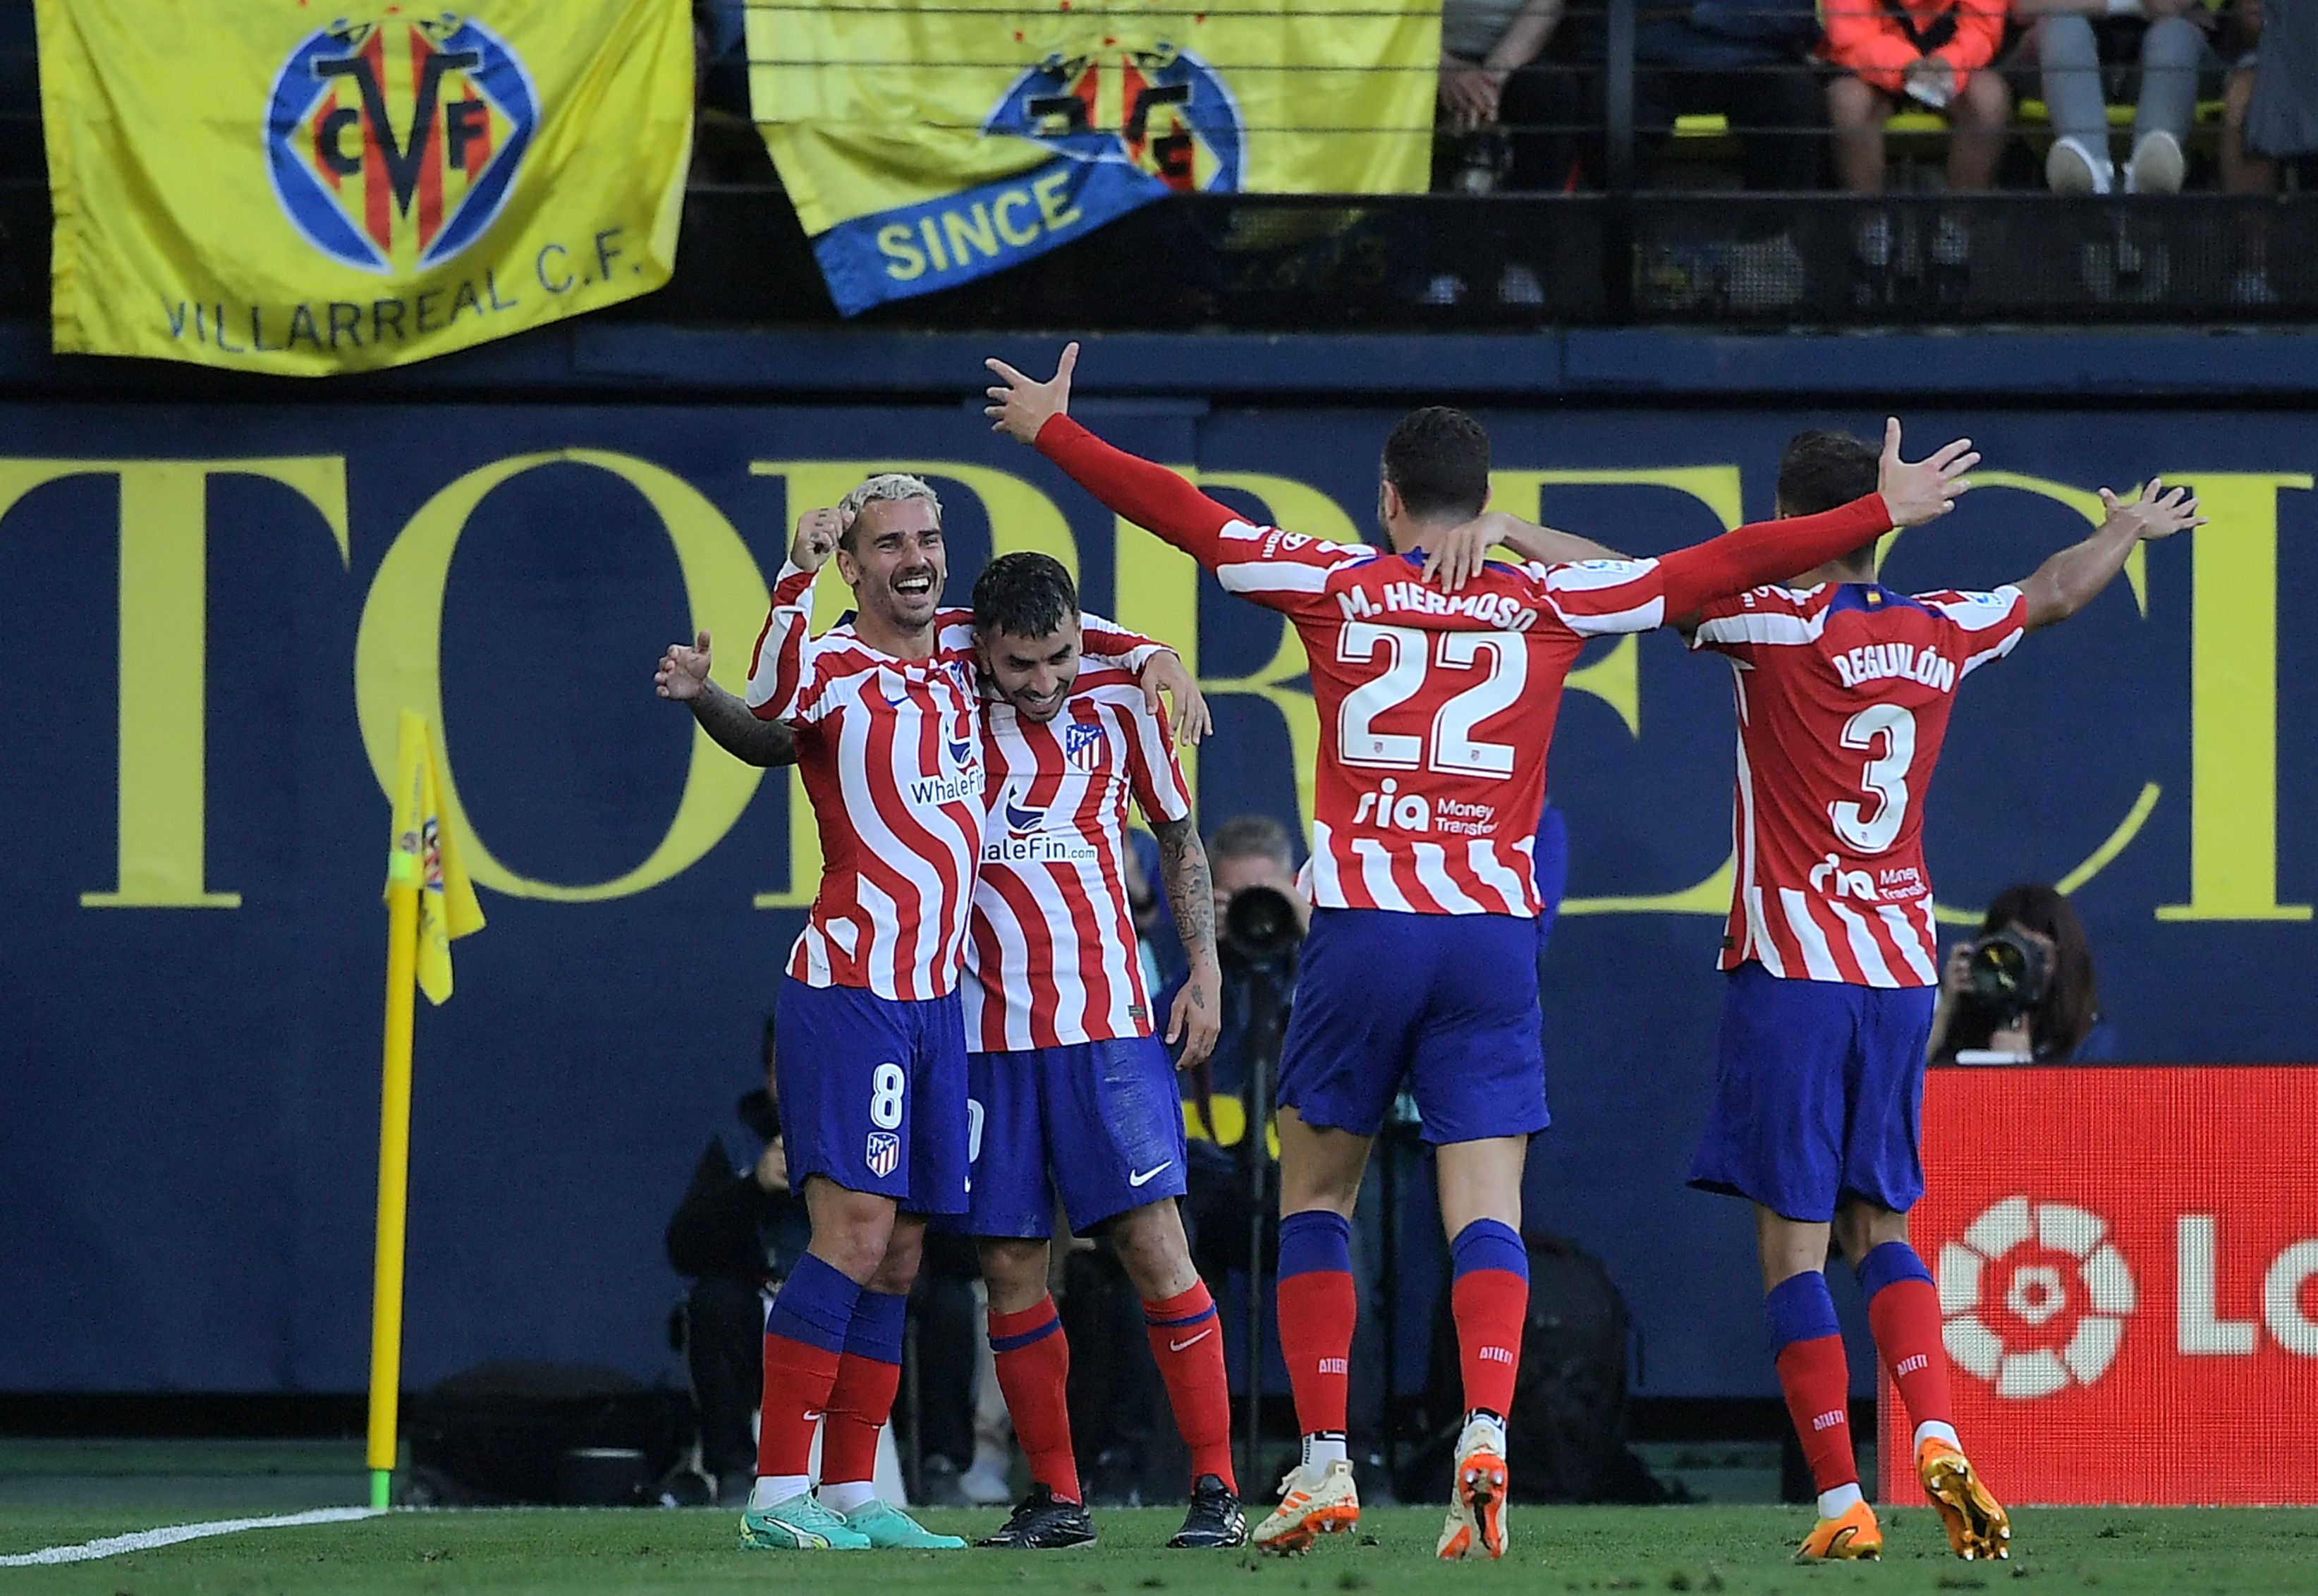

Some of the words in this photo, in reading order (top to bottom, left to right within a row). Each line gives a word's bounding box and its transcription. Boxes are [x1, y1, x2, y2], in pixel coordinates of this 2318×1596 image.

[877, 171, 1082, 281] SINCE
[161, 267, 518, 353] VILLARREAL
[535, 228, 642, 296] C.F.
[1336, 585, 1381, 621] M.
[1384, 581, 1539, 633] HERMOSO
[1336, 621, 1529, 780] 22
[1833, 642, 1958, 693] REGUILÓN
[1352, 776, 1431, 833] ria
[1436, 797, 1495, 822] Money
[1827, 702, 1917, 853] 3
[870, 1062, 905, 1130] 8
